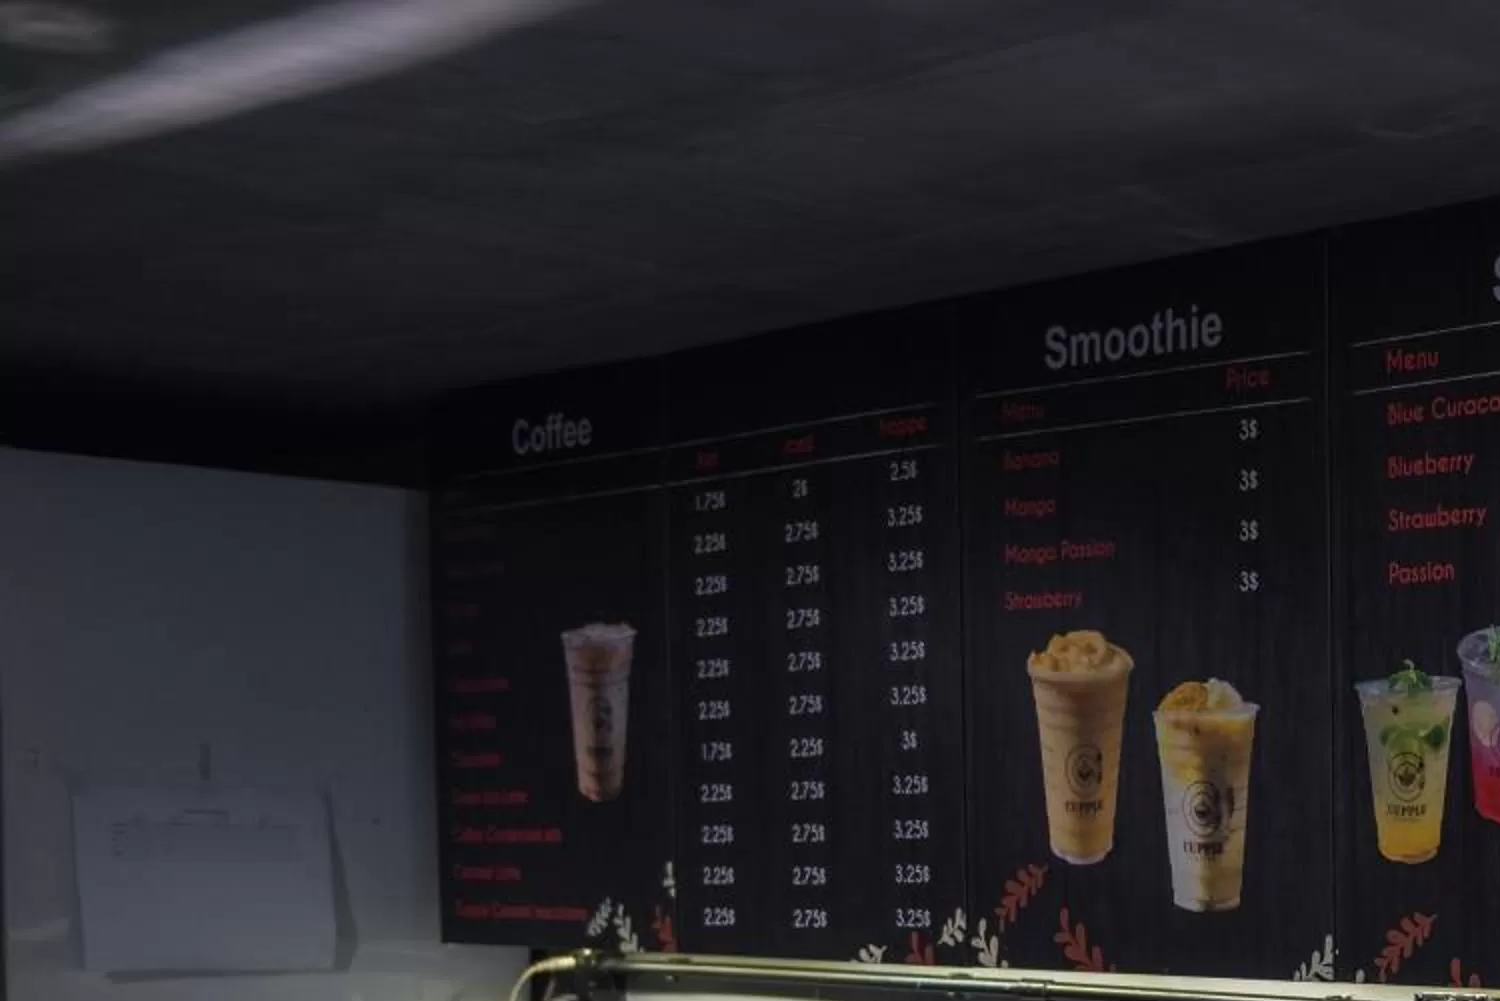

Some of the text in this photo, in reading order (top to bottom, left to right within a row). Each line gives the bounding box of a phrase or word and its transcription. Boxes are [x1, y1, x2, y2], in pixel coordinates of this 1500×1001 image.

[1044, 304, 1224, 370] Smoothie
[1386, 348, 1440, 372] Menu
[512, 411, 593, 455] Coffee
[1239, 418, 1258, 440] 3$
[889, 459, 918, 481] 2.5$
[1387, 451, 1475, 480] Blueberry
[1239, 468, 1258, 491] 3$
[888, 505, 923, 527] 3.25$
[1387, 505, 1488, 532] Strawberry
[1239, 519, 1258, 541] 3$
[887, 551, 923, 572] 3.25$
[1387, 560, 1456, 585] Passion
[1239, 570, 1258, 592] 3$
[889, 595, 924, 616] 3.25$
[889, 641, 925, 661] 3.25$
[891, 685, 927, 705] 3.25$
[902, 730, 917, 750] 3$
[893, 775, 929, 795] 3.25$
[894, 820, 929, 839] 3.25$
[895, 864, 930, 883] 3.25$
[896, 908, 931, 927] 3.25$
